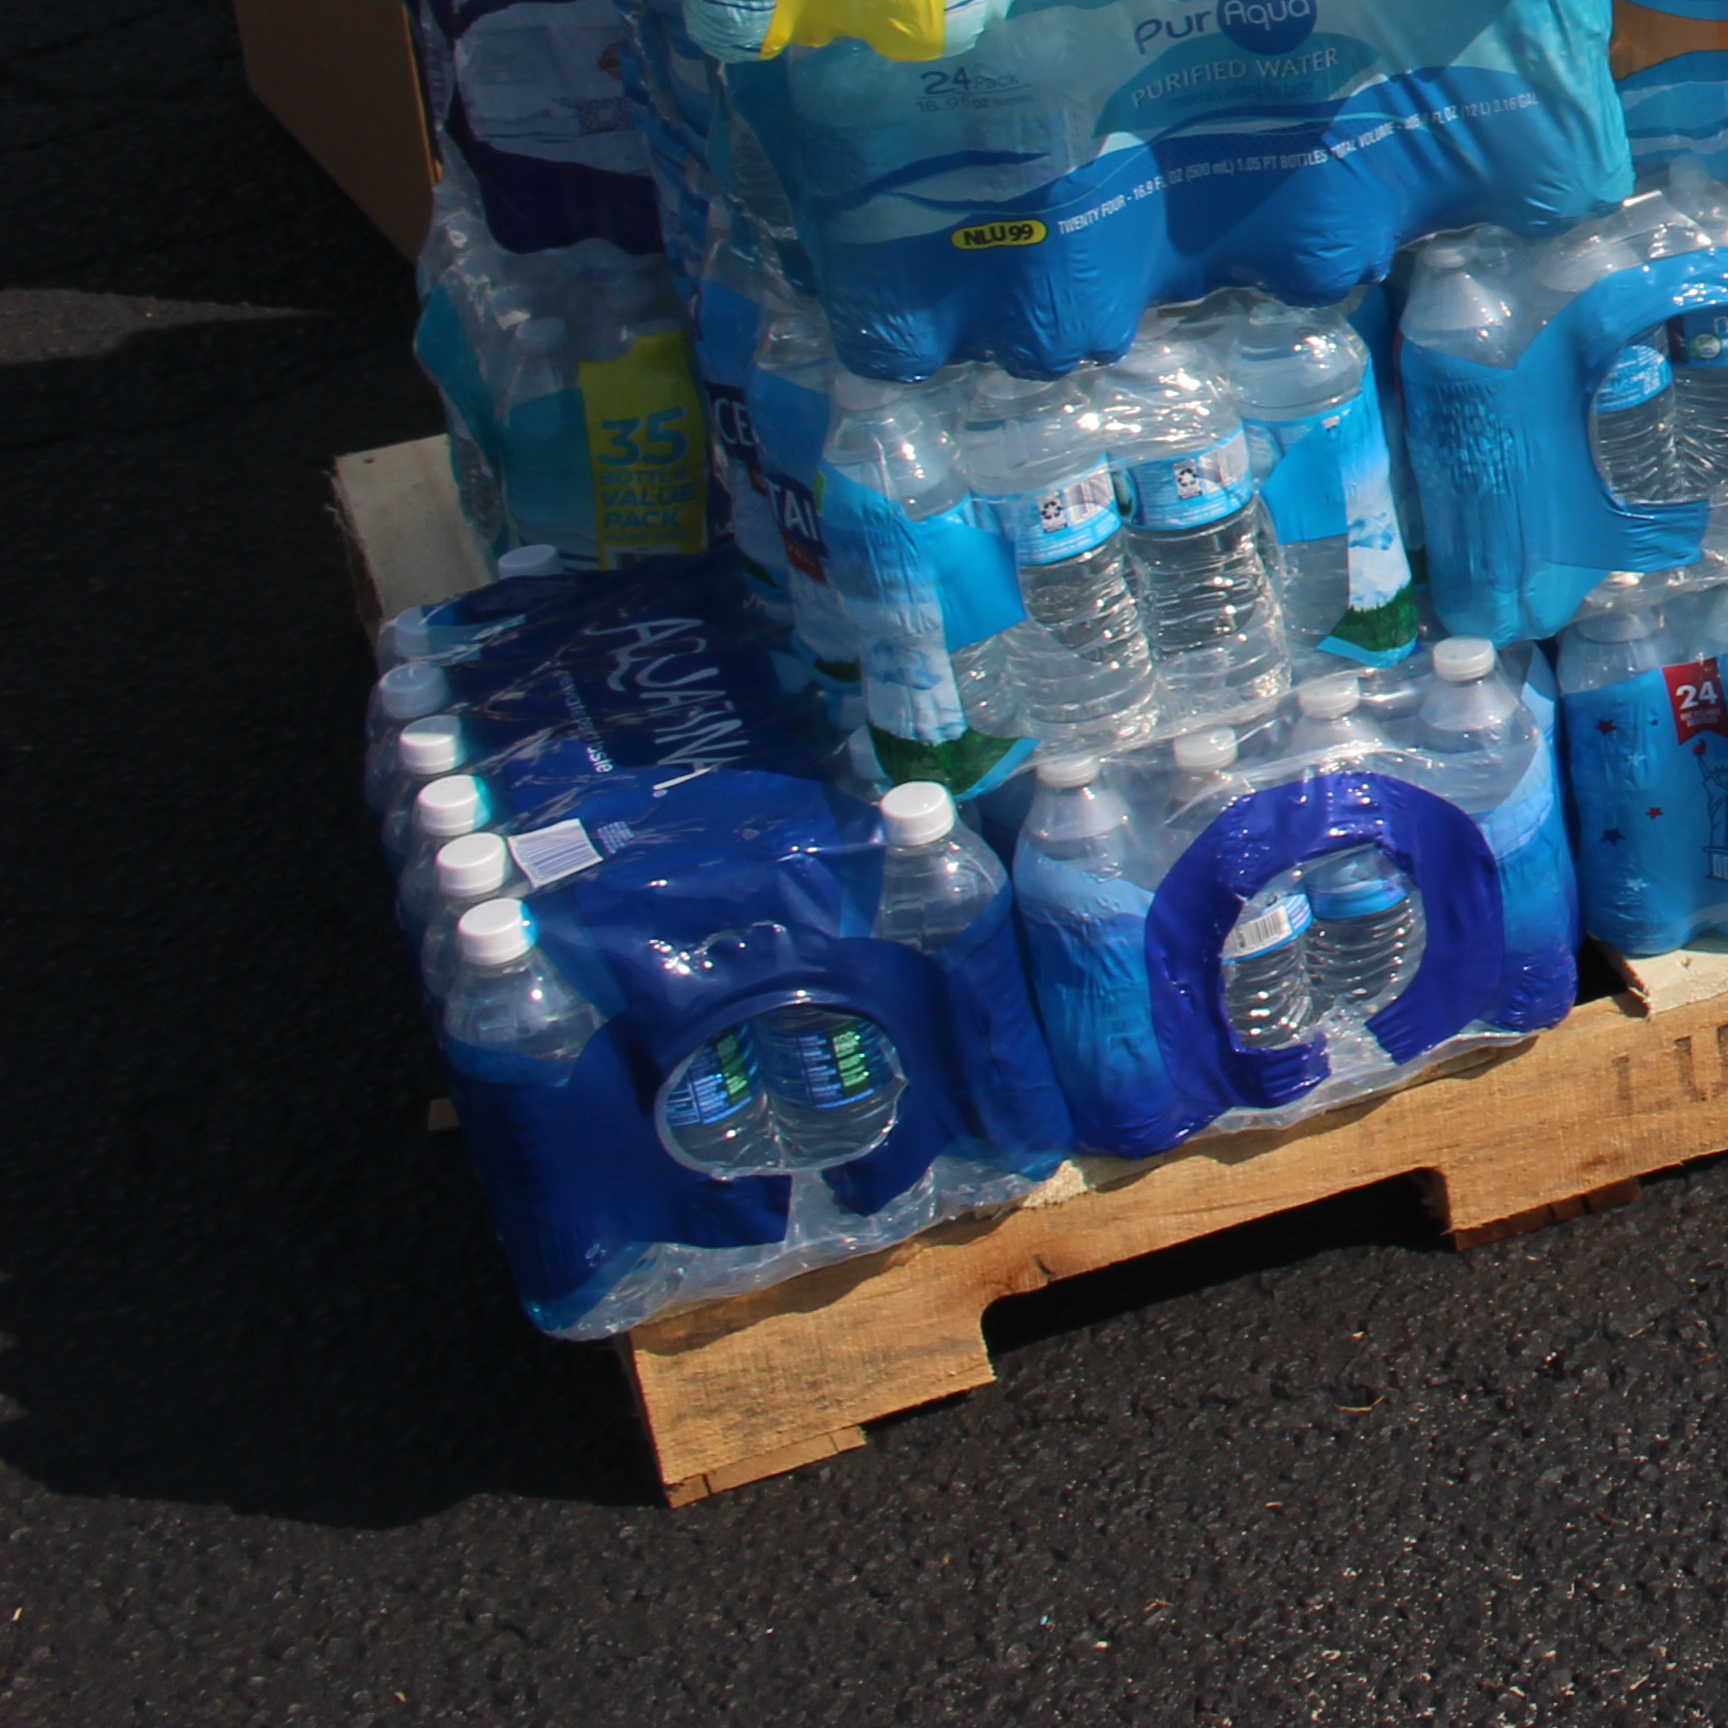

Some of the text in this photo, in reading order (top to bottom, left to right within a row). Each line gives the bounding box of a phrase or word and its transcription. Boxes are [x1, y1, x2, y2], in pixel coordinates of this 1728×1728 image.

[919, 67, 1020, 98] 24 Pack
[1129, 46, 1341, 110] PURIFIED WATER
[1057, 207, 1102, 236] TWENTY
[1101, 193, 1127, 219] FOUR
[1133, 180, 1154, 203] 16.9
[1263, 152, 1278, 172] PT
[1279, 146, 1329, 171] BOTTLES
[1330, 136, 1358, 161] TOTAL
[963, 221, 1037, 249] NLU 99
[601, 405, 691, 469] 35
[604, 507, 682, 531] PACK
[1675, 681, 1719, 710] 24
